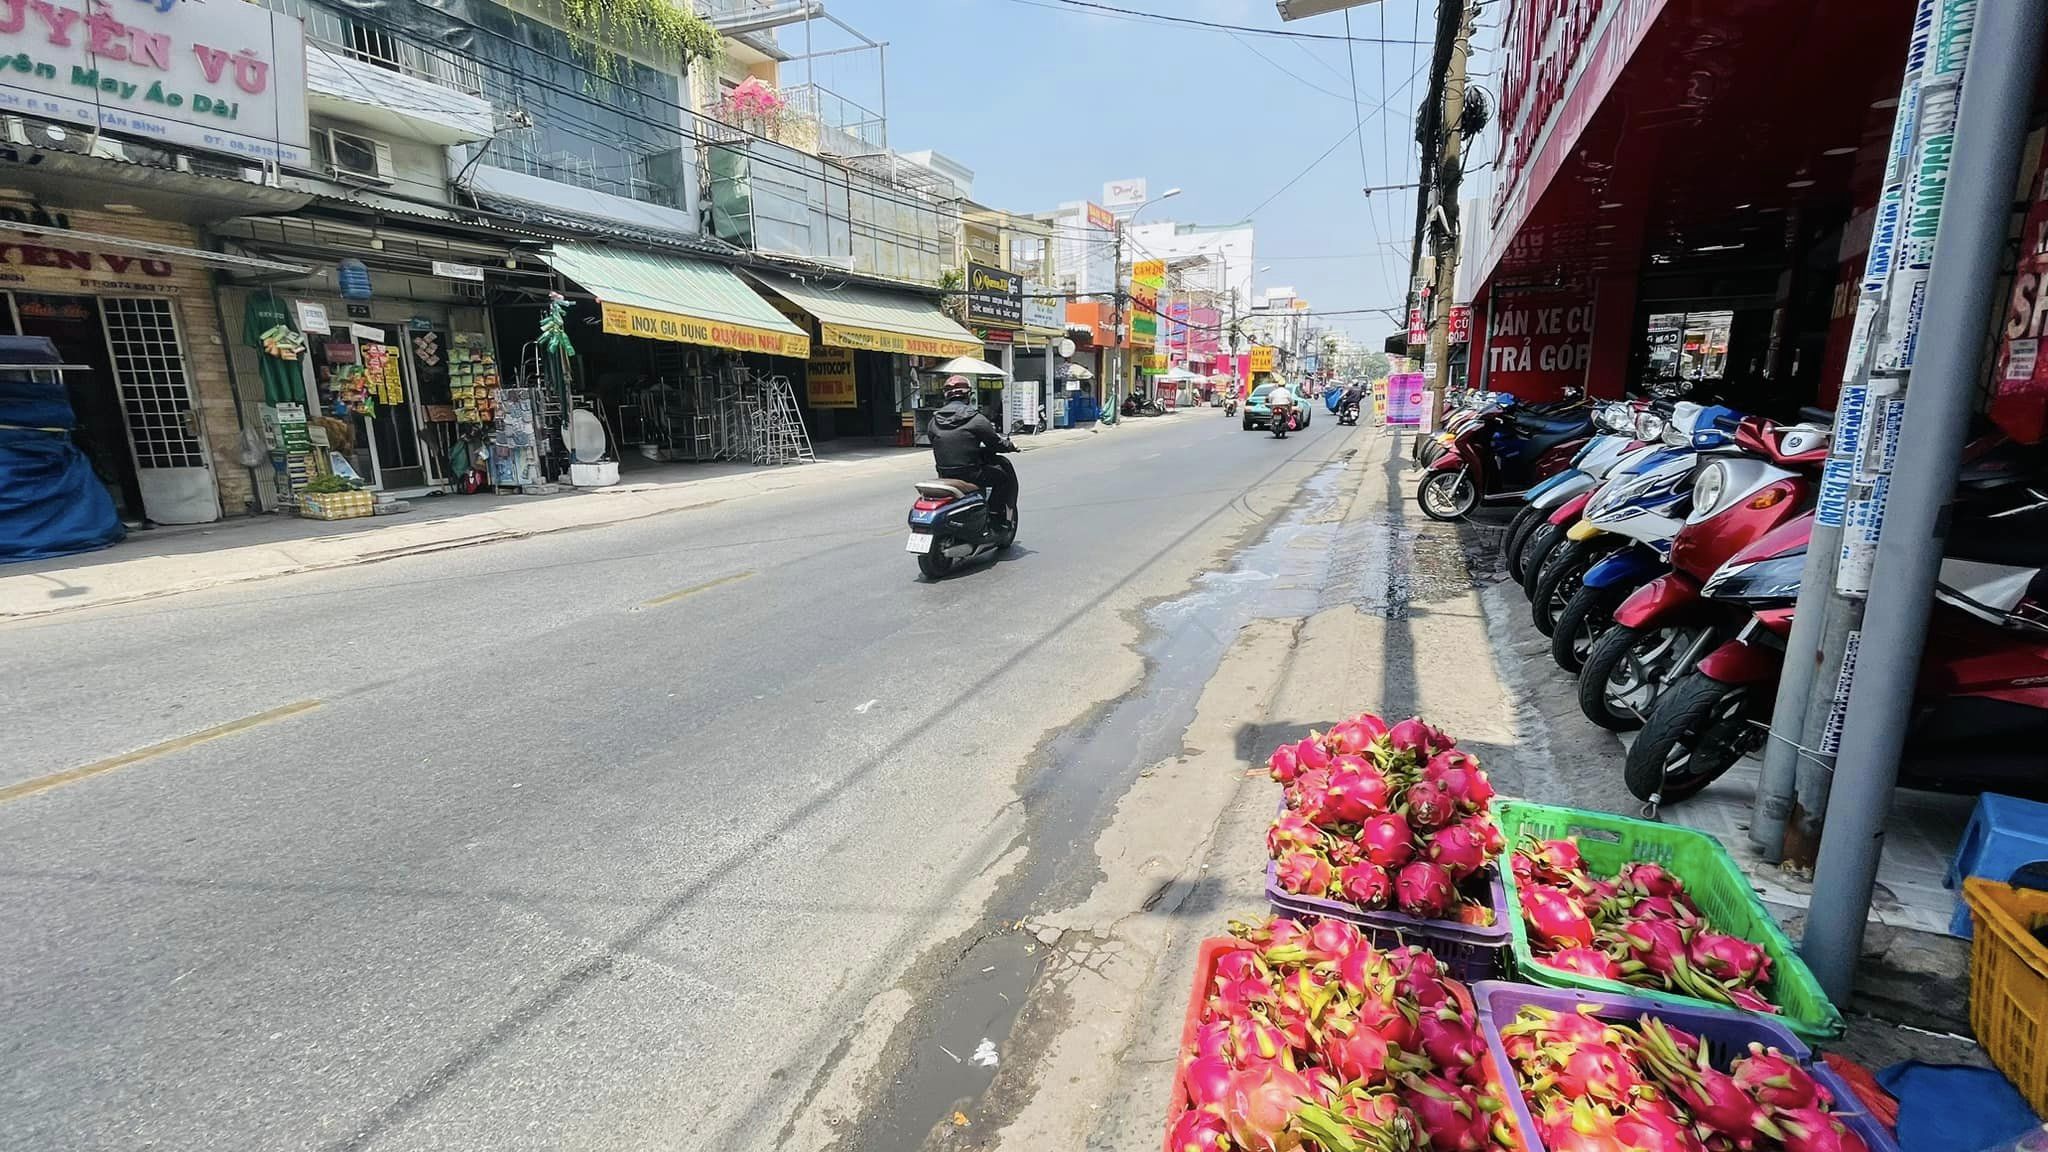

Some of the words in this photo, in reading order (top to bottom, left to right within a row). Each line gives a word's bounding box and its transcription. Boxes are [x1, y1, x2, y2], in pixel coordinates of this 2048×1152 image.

[71, 65, 138, 100] May
[145, 79, 184, 107] Áo
[192, 93, 240, 121] Dài
[131, 119, 166, 135] BÌNH
[631, 315, 658, 334] INOX
[661, 319, 678, 337] GIA
[1536, 308, 1563, 335] XE
[906, 339, 938, 353] MINH
[1489, 337, 1532, 373] TRẢ
[1540, 338, 1591, 372] GÓP
[808, 361, 851, 377] PHOTOCOPY
